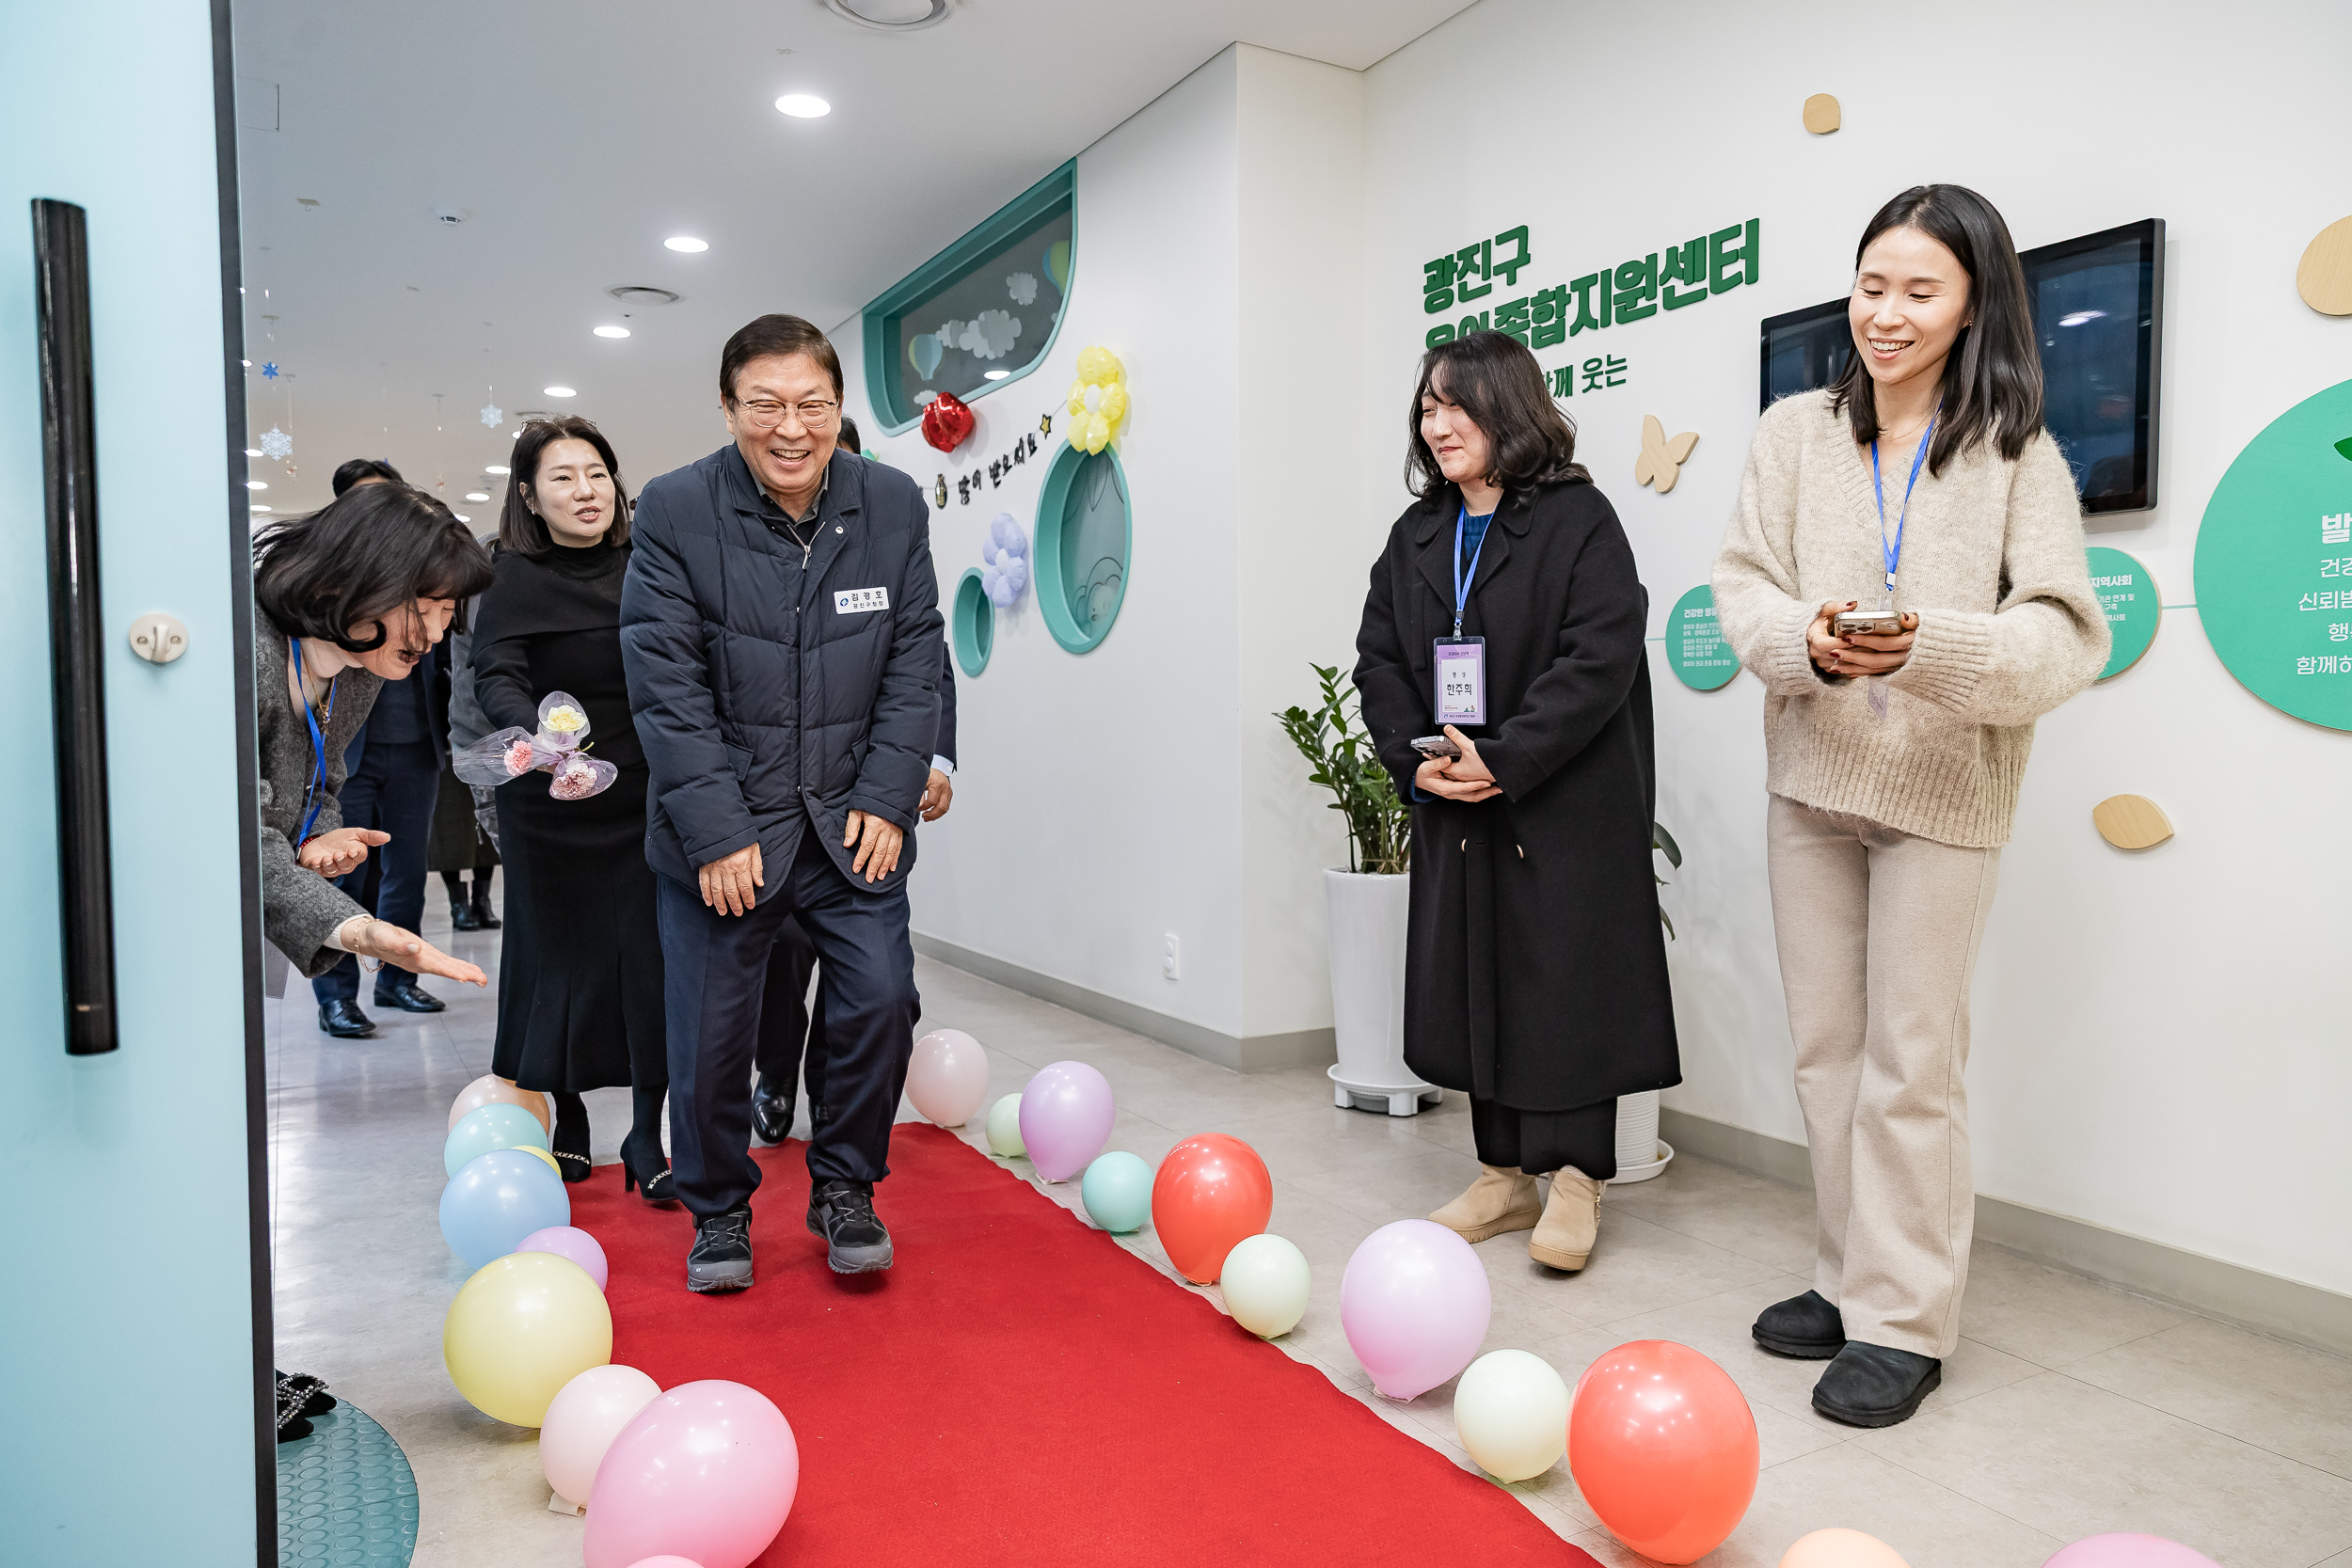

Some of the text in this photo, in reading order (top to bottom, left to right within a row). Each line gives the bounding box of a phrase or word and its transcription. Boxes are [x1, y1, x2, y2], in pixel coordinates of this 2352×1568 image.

[1423, 225, 1531, 314] 광진구
[1581, 355, 1628, 394] 웃는
[2090, 574, 2133, 588] 지역사회
[2127, 593, 2135, 601] 및
[1684, 609, 1704, 618] 건강한
[2328, 622, 2352, 642] 행
[1446, 684, 1472, 696] 한주희
